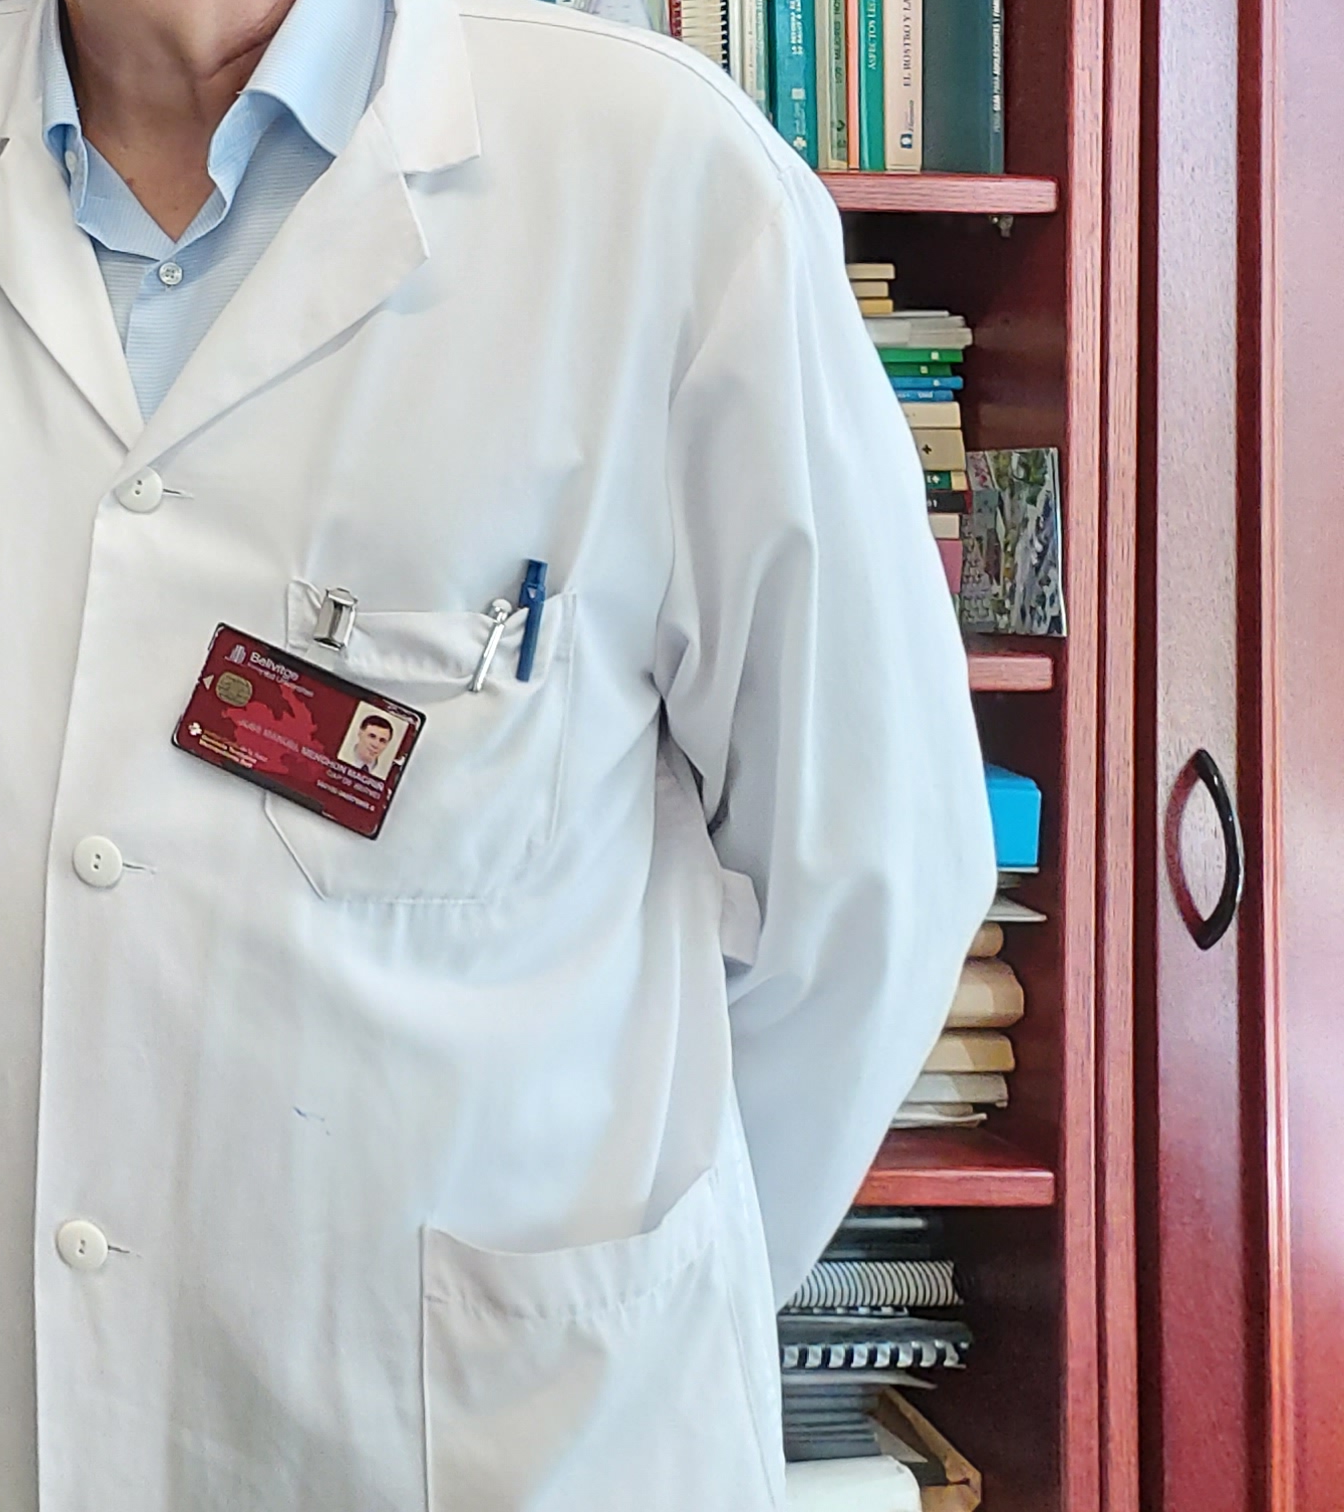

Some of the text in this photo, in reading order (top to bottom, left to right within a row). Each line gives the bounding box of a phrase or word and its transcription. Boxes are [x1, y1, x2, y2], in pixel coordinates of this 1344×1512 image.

[867, 19, 877, 70] ASPECTOS
[903, 25, 912, 71] ROSTRO
[903, 72, 912, 87] EL
